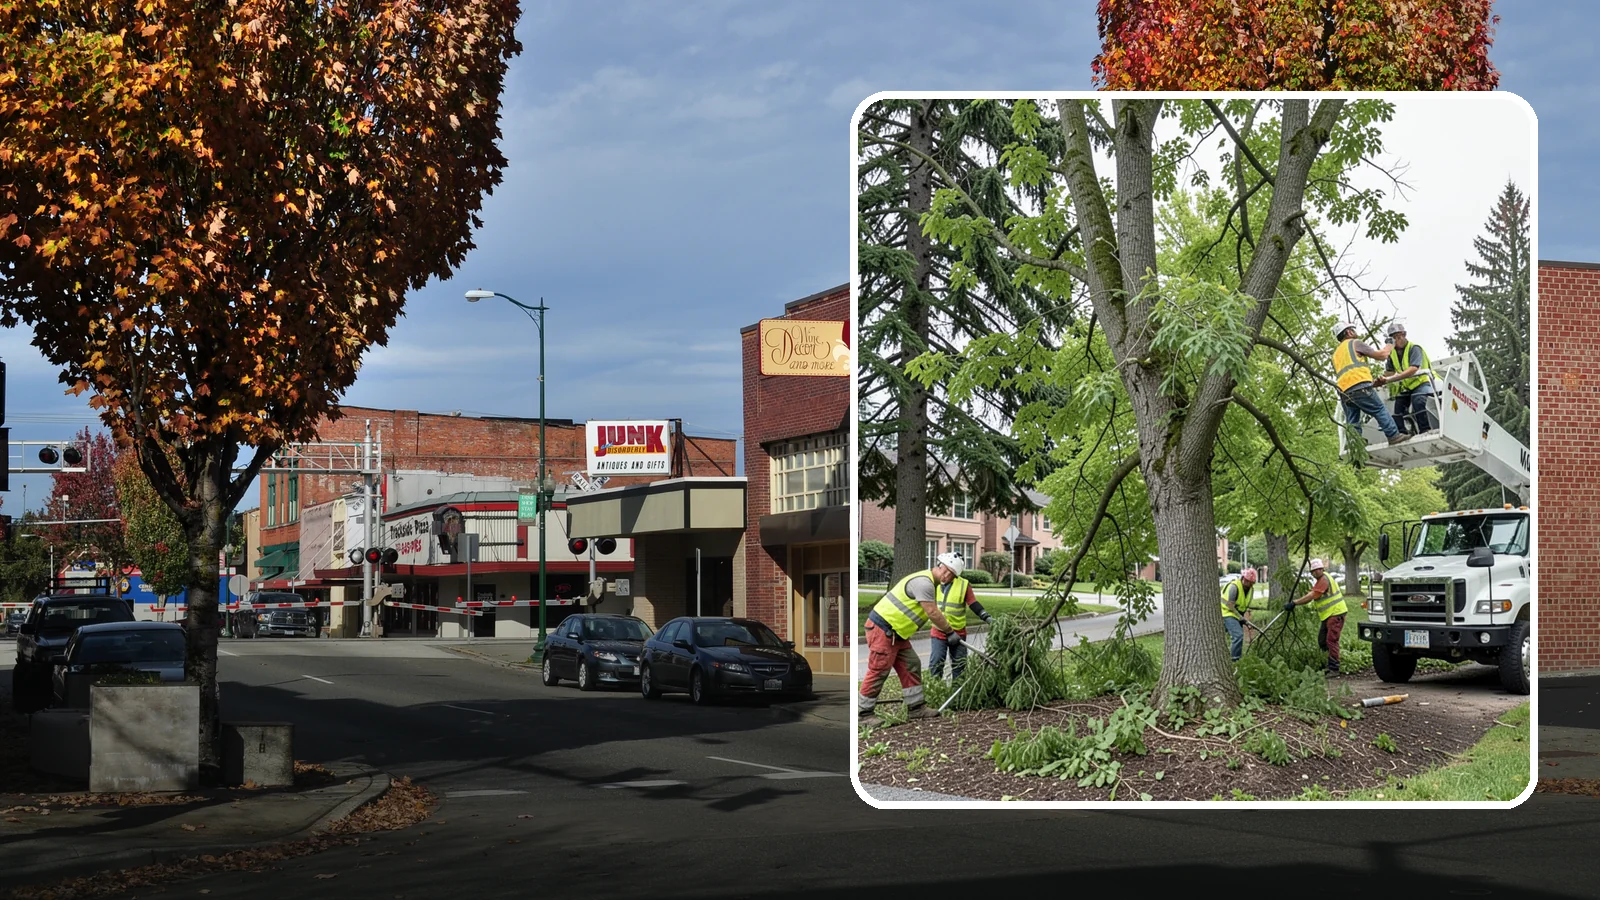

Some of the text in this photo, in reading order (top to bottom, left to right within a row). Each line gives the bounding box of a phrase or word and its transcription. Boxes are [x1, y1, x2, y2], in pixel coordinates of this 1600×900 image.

[595, 425, 665, 457] JUNK
[597, 460, 665, 470] ANTIQUES AND GIFTS
[390, 520, 429, 540] Trackside Pizza
